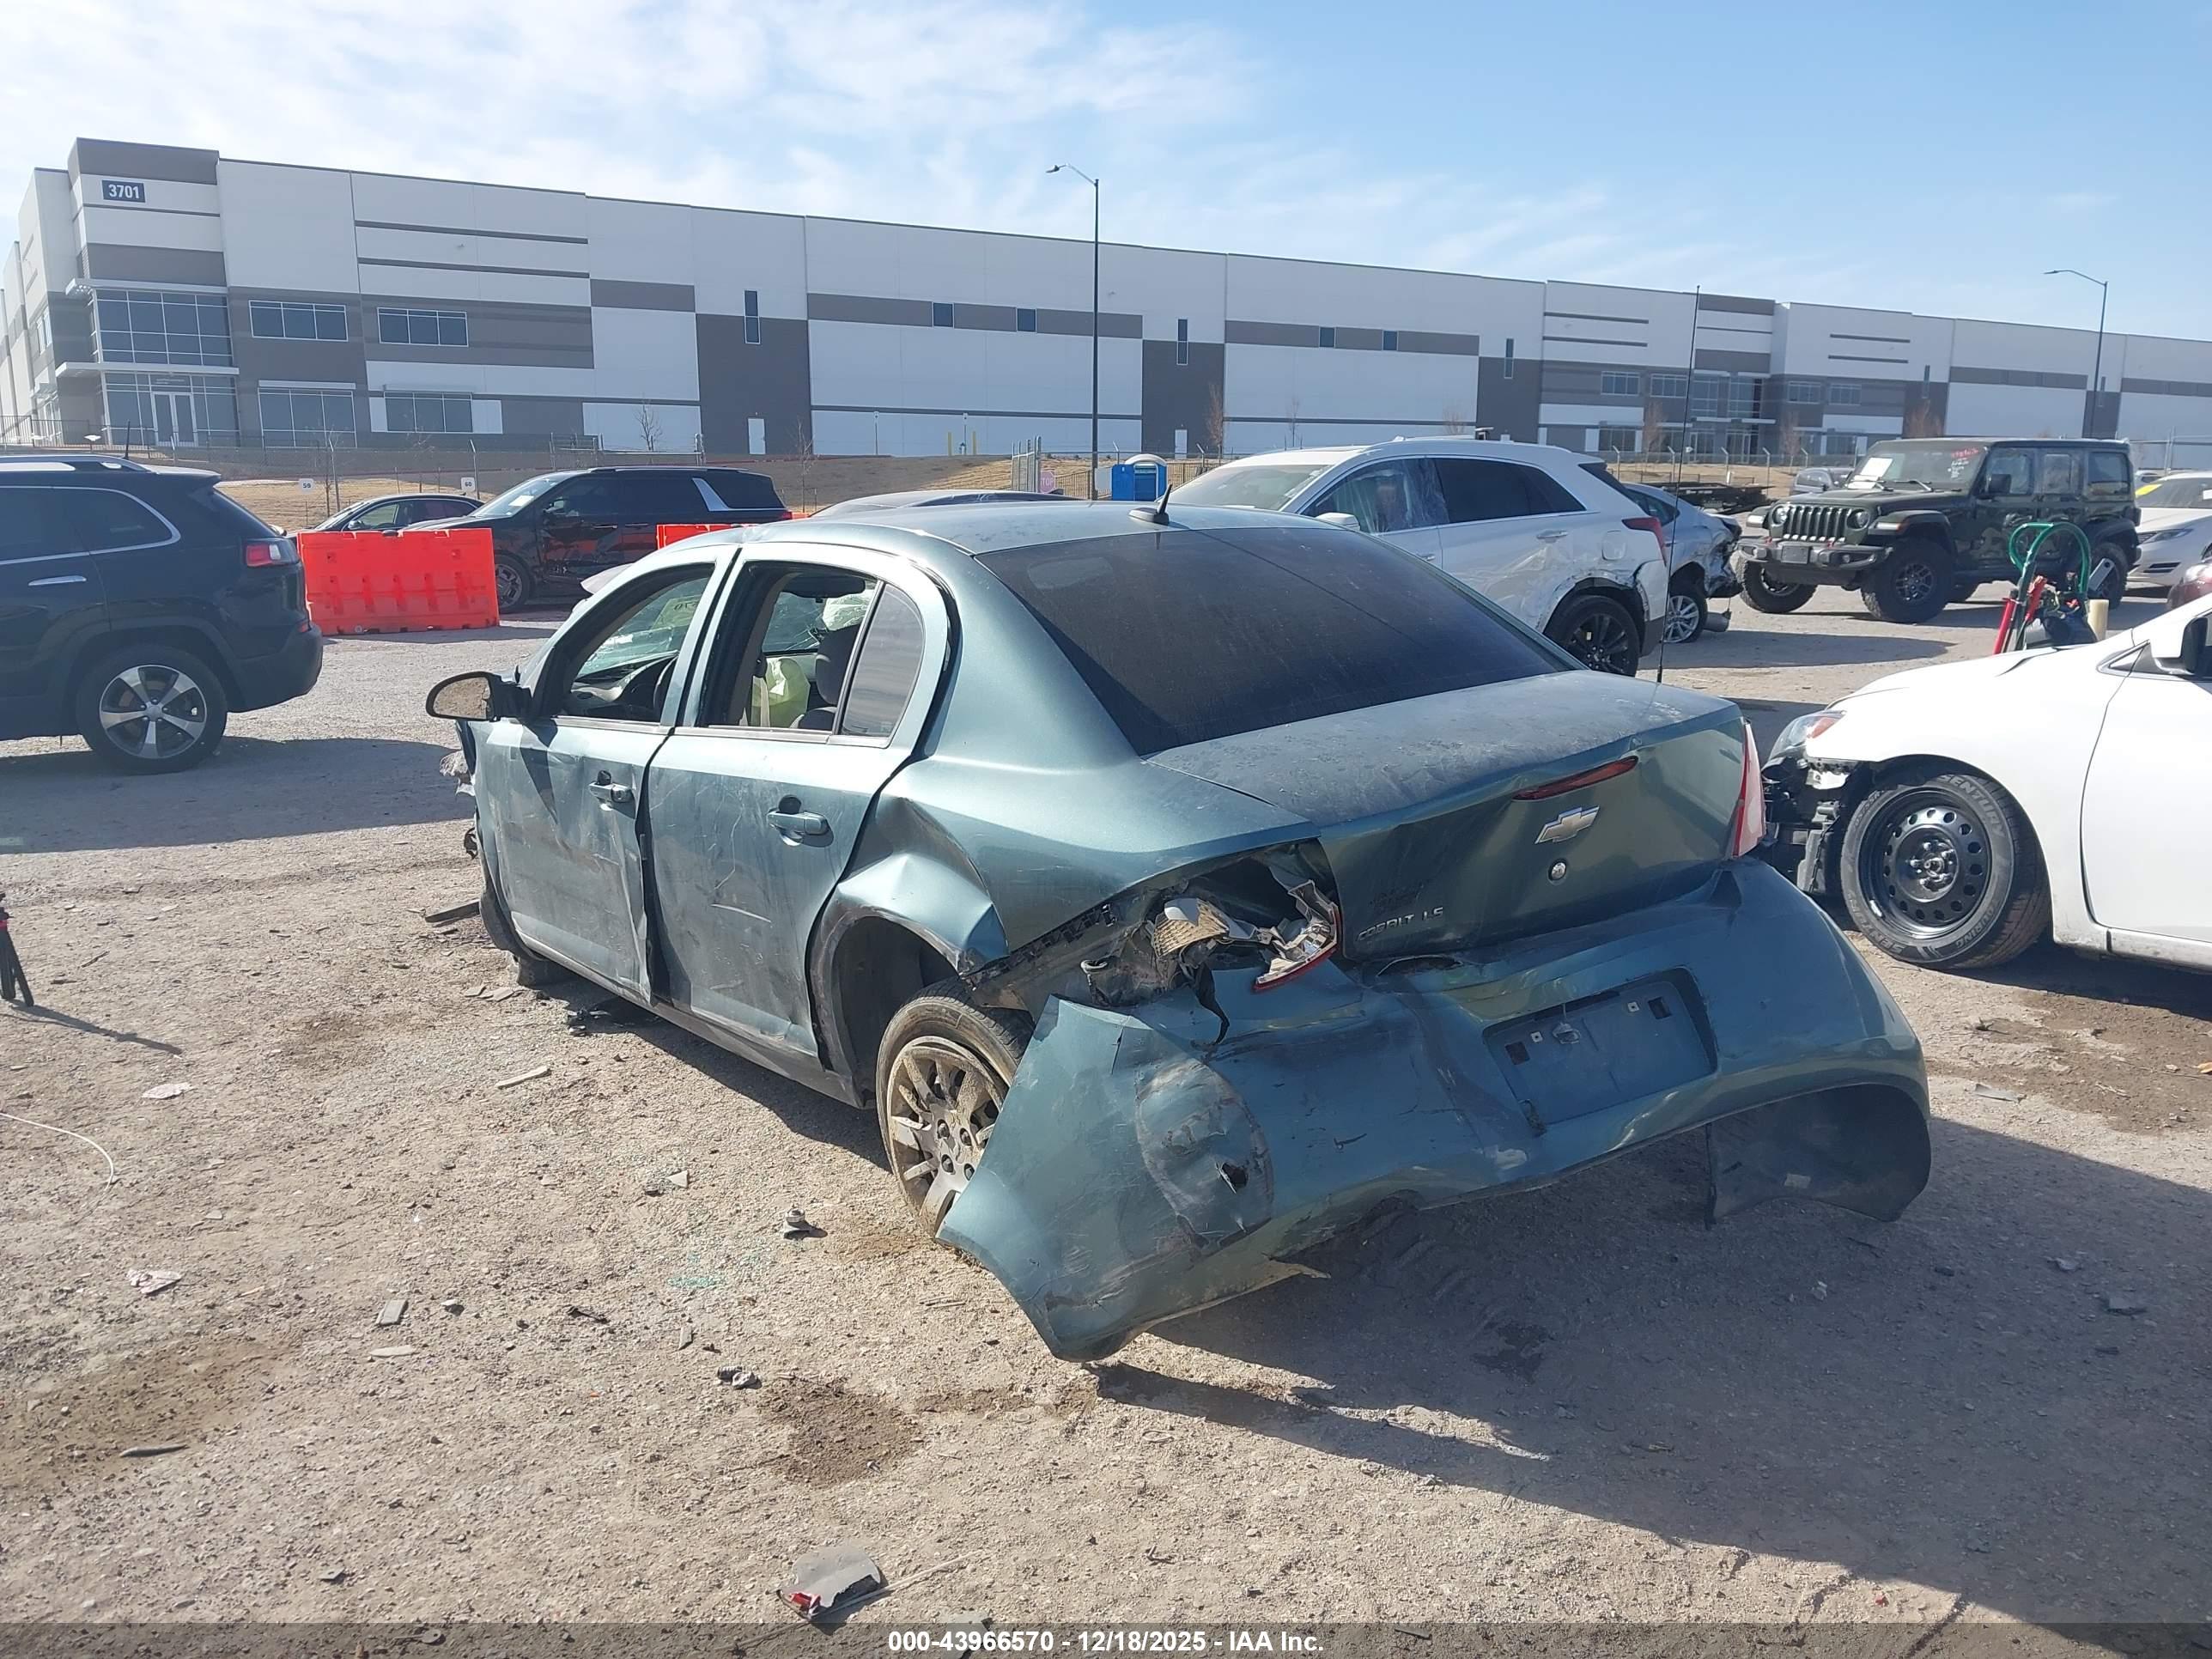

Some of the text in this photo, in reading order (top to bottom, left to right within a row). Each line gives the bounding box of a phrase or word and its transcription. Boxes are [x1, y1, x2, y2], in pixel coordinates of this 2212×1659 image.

[108, 184, 140, 199] 3701
[1936, 775, 2006, 838] SENTURY
[1354, 906, 1444, 942] COBALT LS
